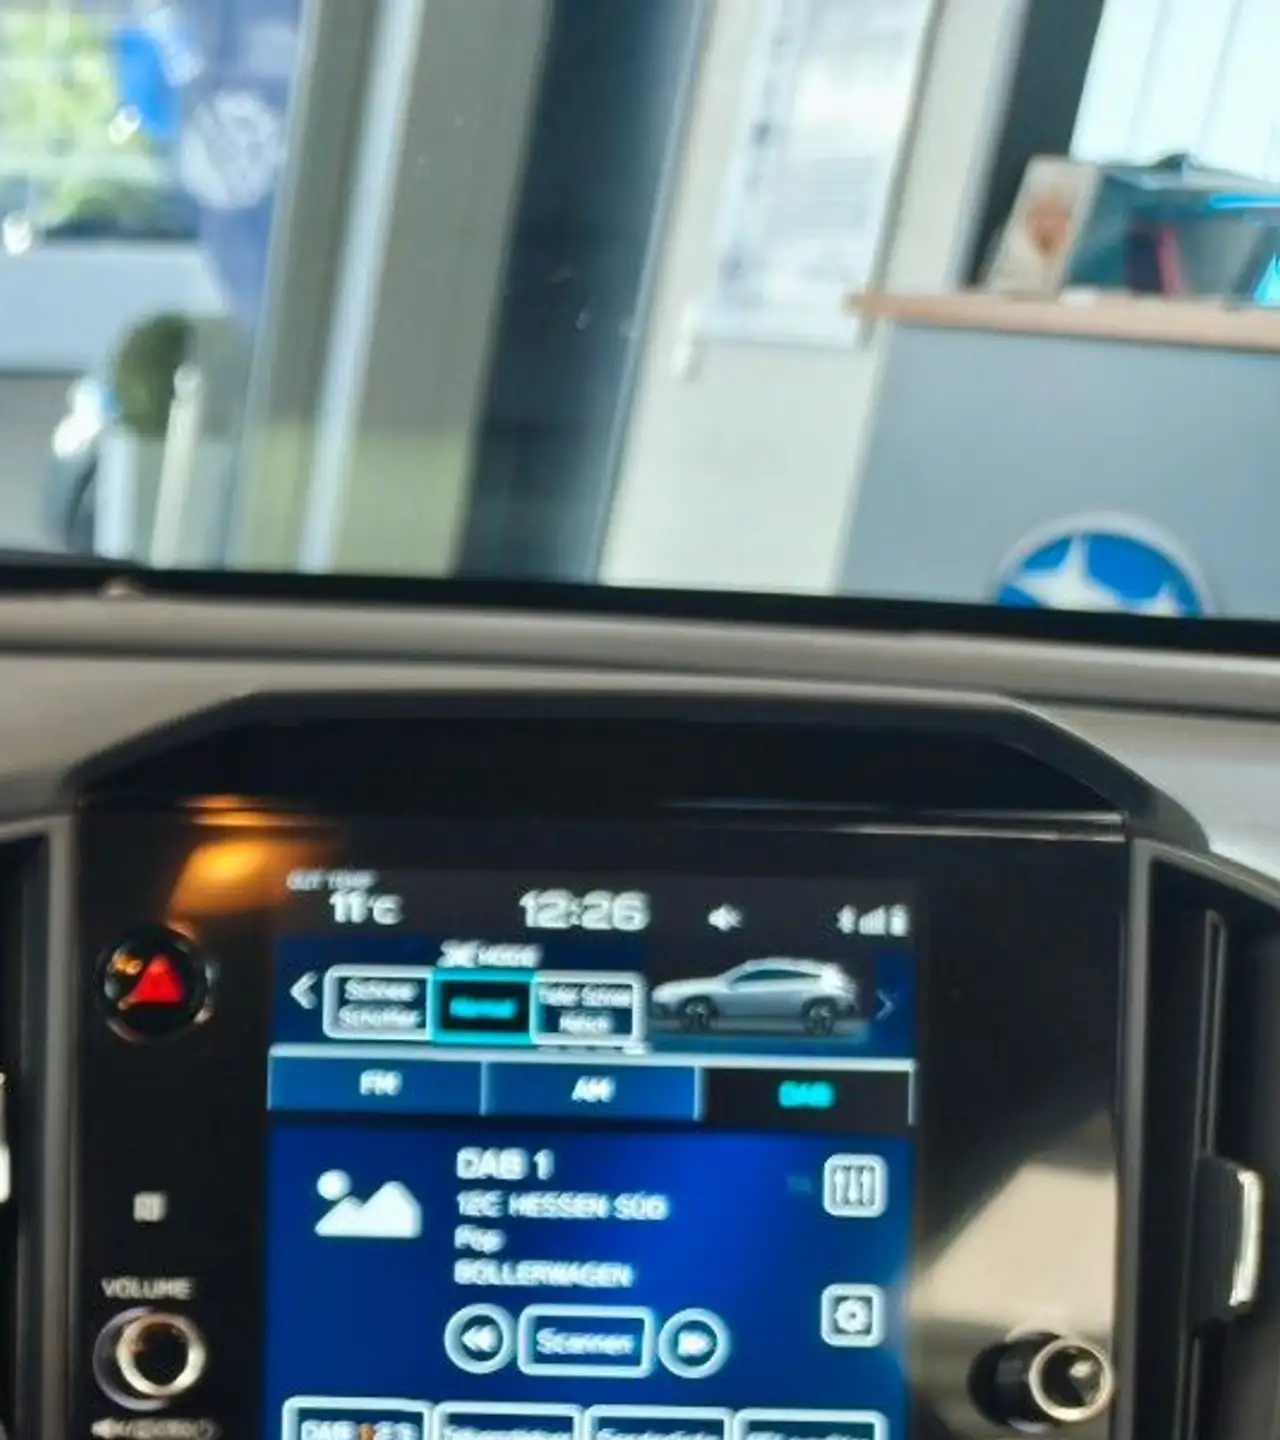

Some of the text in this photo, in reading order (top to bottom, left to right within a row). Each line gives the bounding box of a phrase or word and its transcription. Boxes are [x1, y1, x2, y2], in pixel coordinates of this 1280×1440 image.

[520, 889, 650, 931] 12:26
[570, 1077, 616, 1102] AM
[457, 1147, 554, 1180] DAB 1
[101, 1277, 195, 1300] VOLUME
